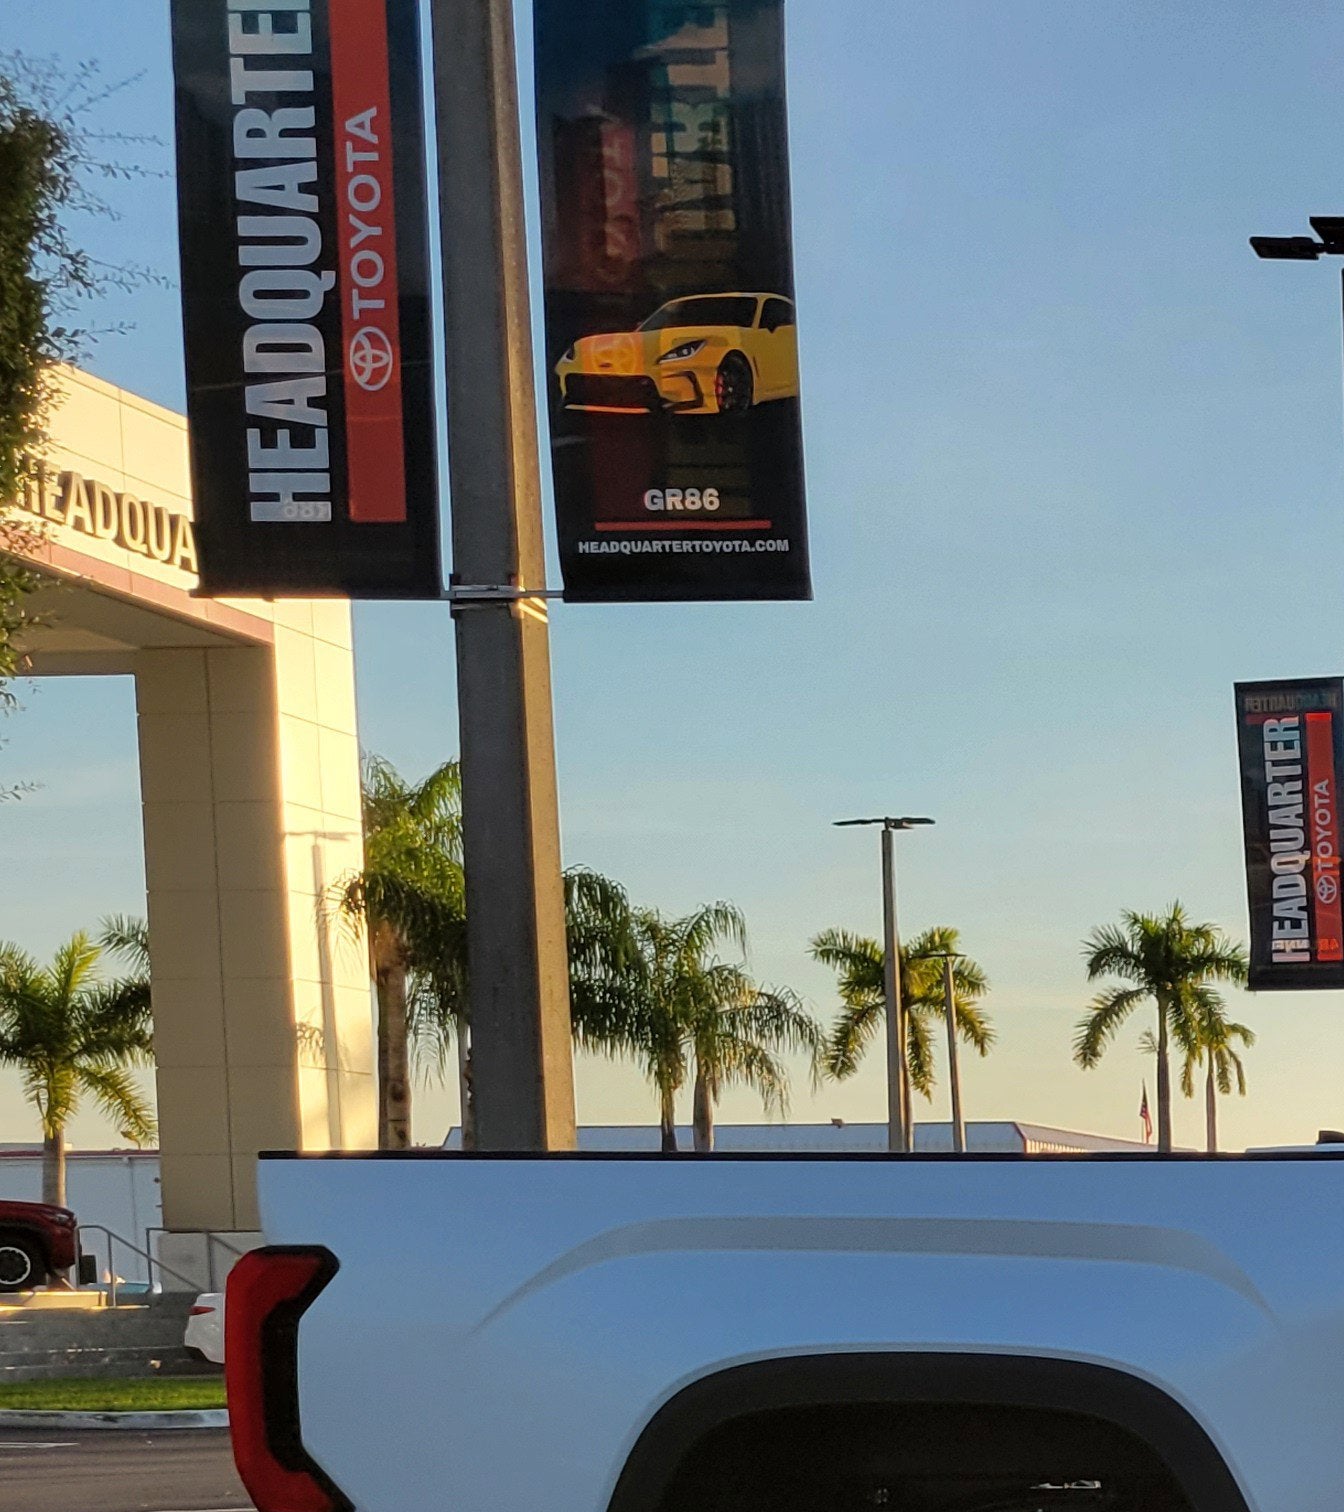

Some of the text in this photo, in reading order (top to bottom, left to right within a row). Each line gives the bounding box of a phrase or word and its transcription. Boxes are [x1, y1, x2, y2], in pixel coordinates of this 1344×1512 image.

[227, 0, 337, 521] HEADQUARTE
[346, 106, 385, 320] TOYOTA
[578, 539, 789, 555] HEADQUARTERTOYOTA.COM
[643, 487, 720, 511] GR86
[1263, 715, 1311, 963] HEADQUARTER
[1313, 779, 1334, 872] TOYOTA
